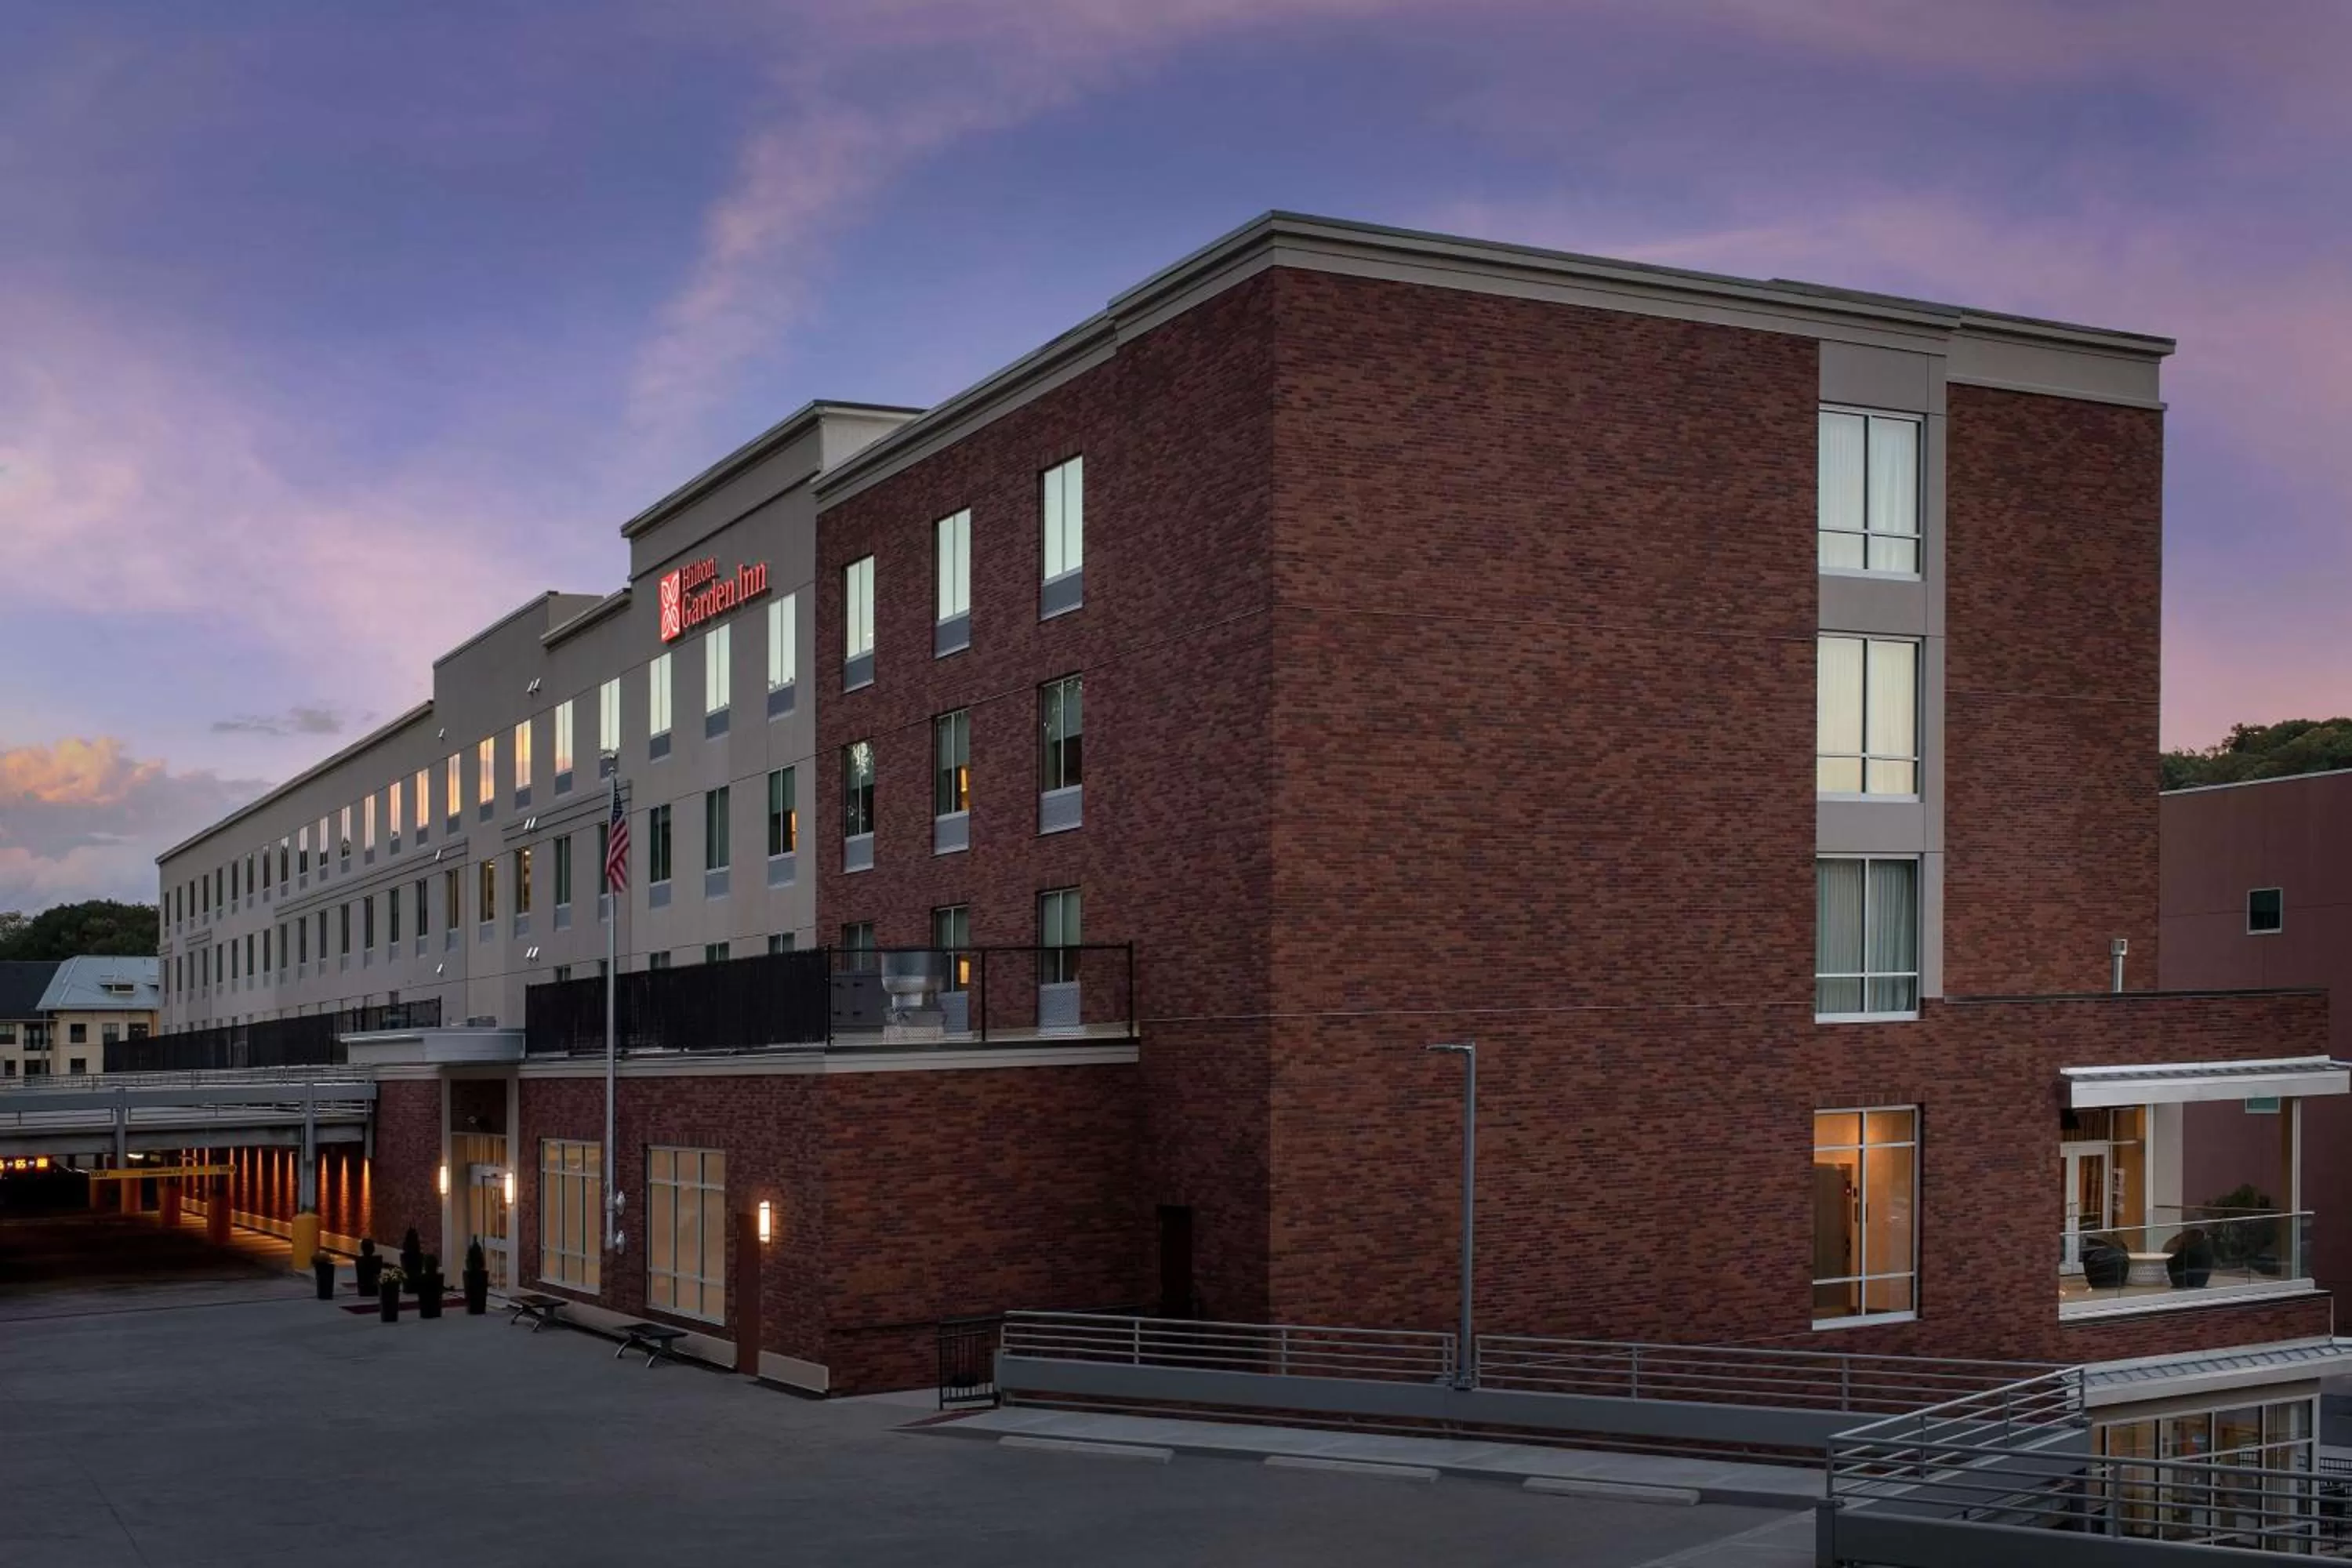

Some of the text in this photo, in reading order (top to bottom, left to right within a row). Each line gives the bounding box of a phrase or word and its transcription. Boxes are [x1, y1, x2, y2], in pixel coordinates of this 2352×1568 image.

[681, 557, 715, 591] Hilton
[681, 563, 766, 628] Garden Inn
